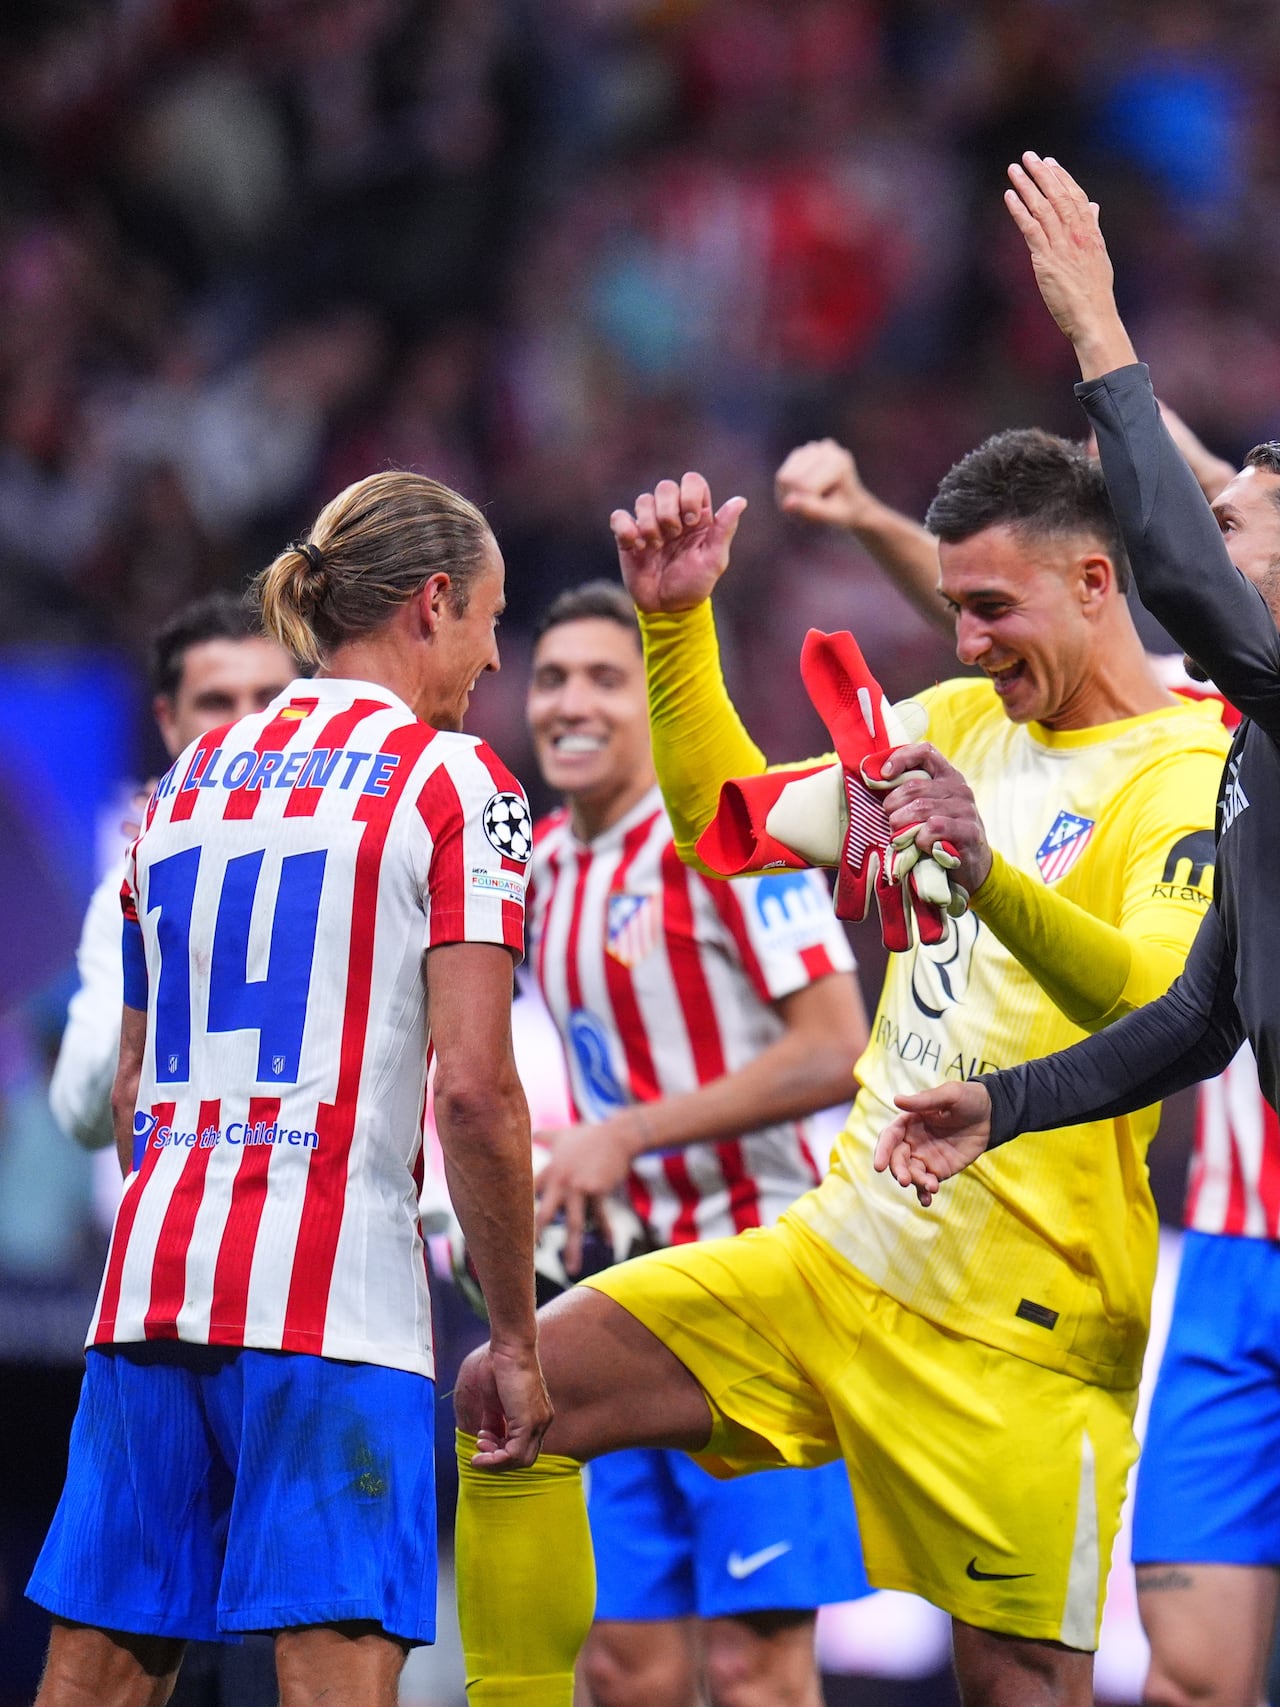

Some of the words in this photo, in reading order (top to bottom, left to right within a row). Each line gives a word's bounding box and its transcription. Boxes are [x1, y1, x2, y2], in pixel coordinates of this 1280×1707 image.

[184, 749, 399, 796] LLORENTE
[472, 877, 522, 893] FOUNDATIO
[1152, 884, 1211, 905] krak
[147, 845, 328, 1083] 14
[155, 1127, 197, 1149] Save
[200, 1125, 221, 1148] the
[225, 1123, 319, 1148] Children
